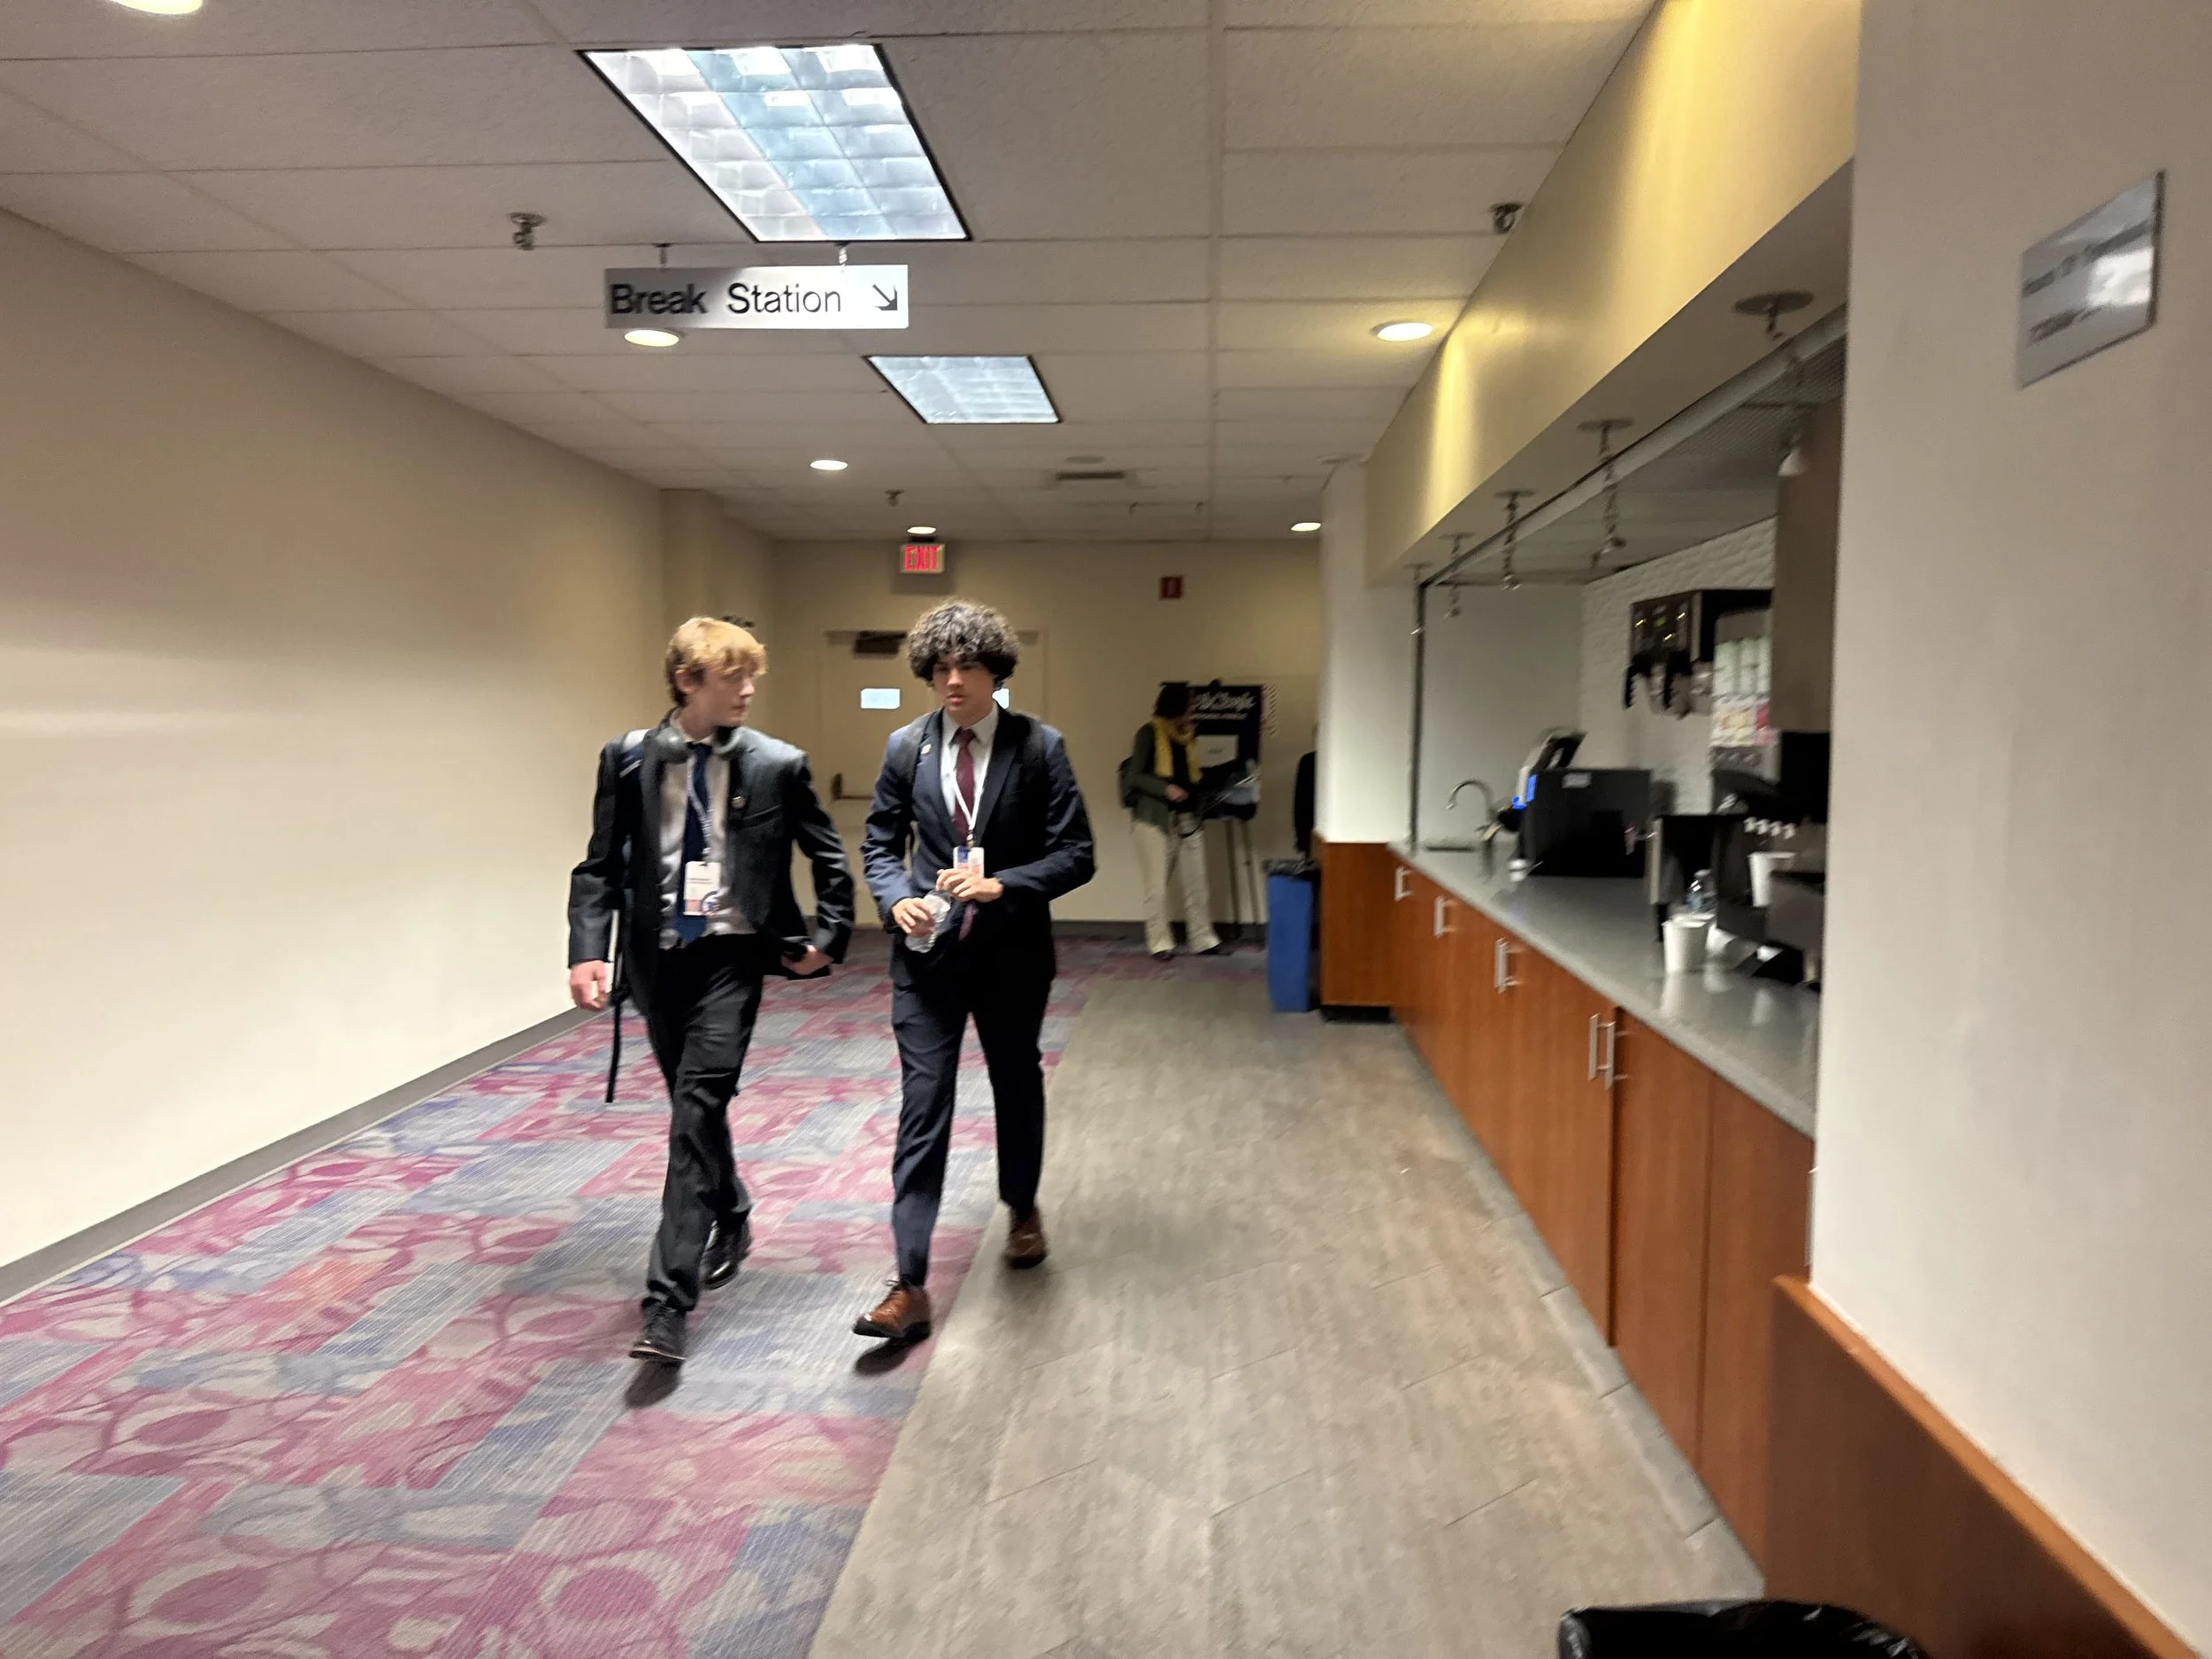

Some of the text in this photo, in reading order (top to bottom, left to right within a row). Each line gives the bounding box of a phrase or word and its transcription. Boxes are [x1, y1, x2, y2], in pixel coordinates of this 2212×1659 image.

[611, 282, 841, 314] Break Station
[905, 546, 939, 571] EXIT
